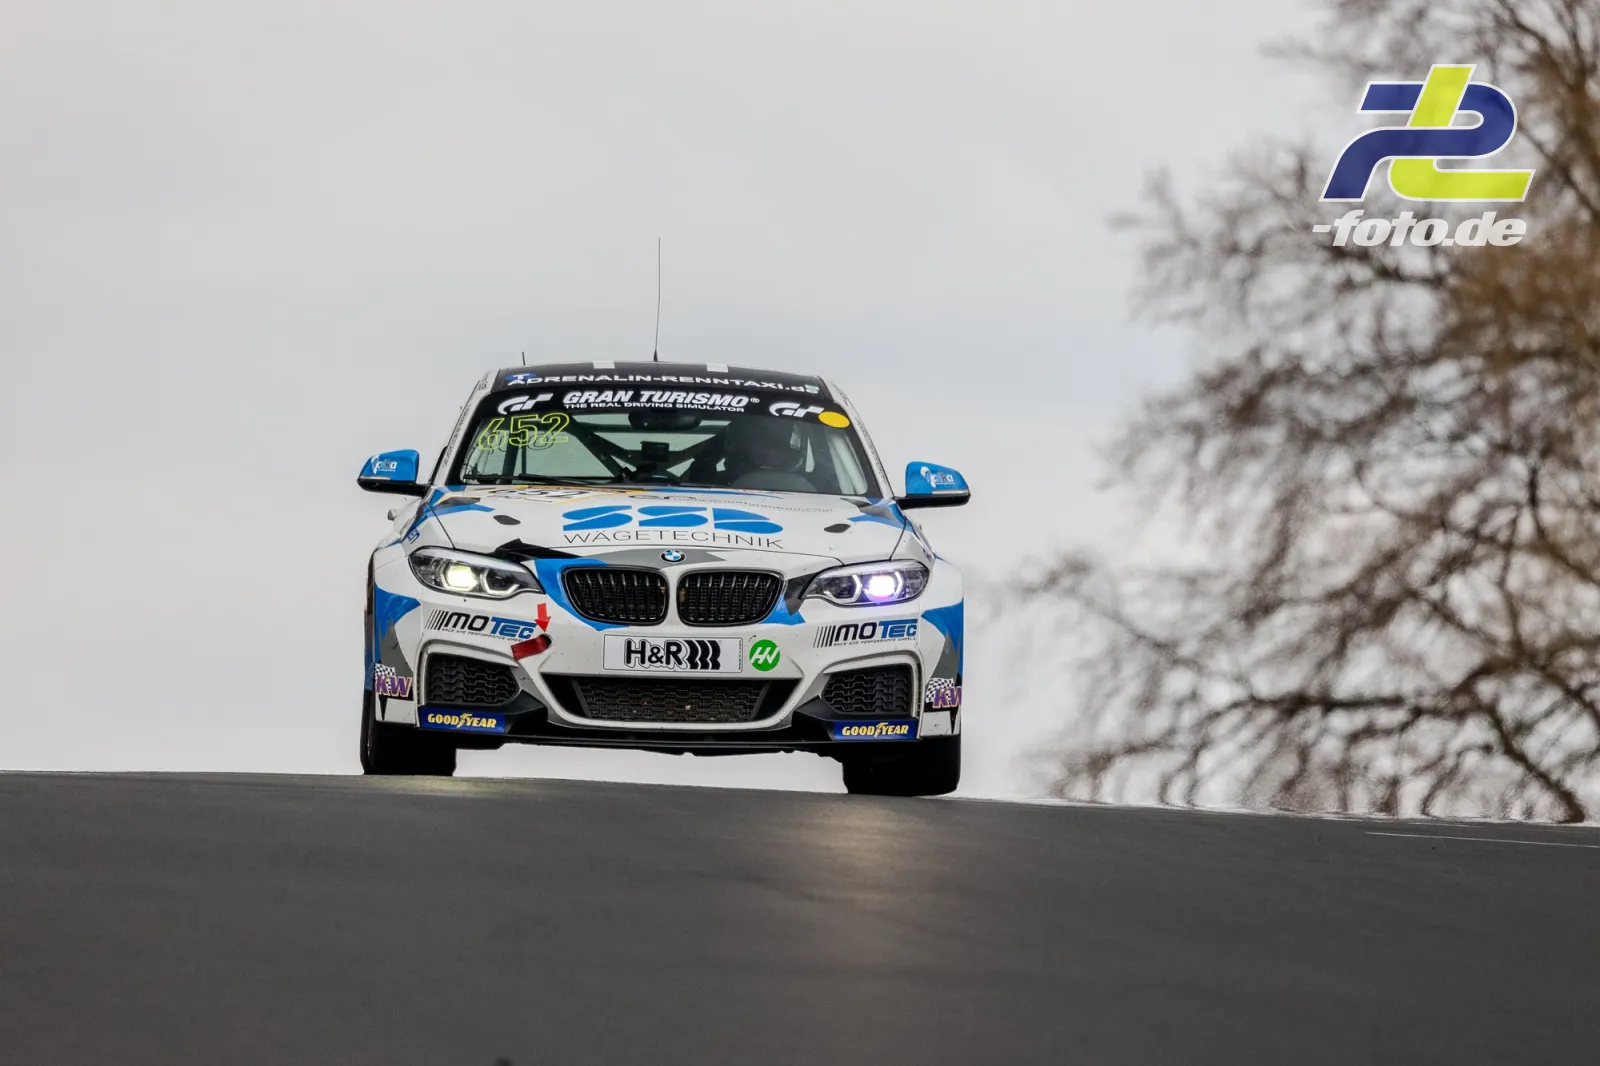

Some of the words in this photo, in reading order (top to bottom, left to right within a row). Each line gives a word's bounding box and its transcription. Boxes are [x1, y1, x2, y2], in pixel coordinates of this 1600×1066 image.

[562, 390, 634, 404] GRAN
[675, 402, 745, 413] SIMULATOR
[478, 412, 570, 451] 652
[563, 530, 784, 550] WÄGETECHNIK
[624, 638, 688, 670] H&R
[375, 674, 413, 698] KW
[427, 712, 497, 729] GOODYEAR
[841, 721, 910, 739] GOODYEAR
